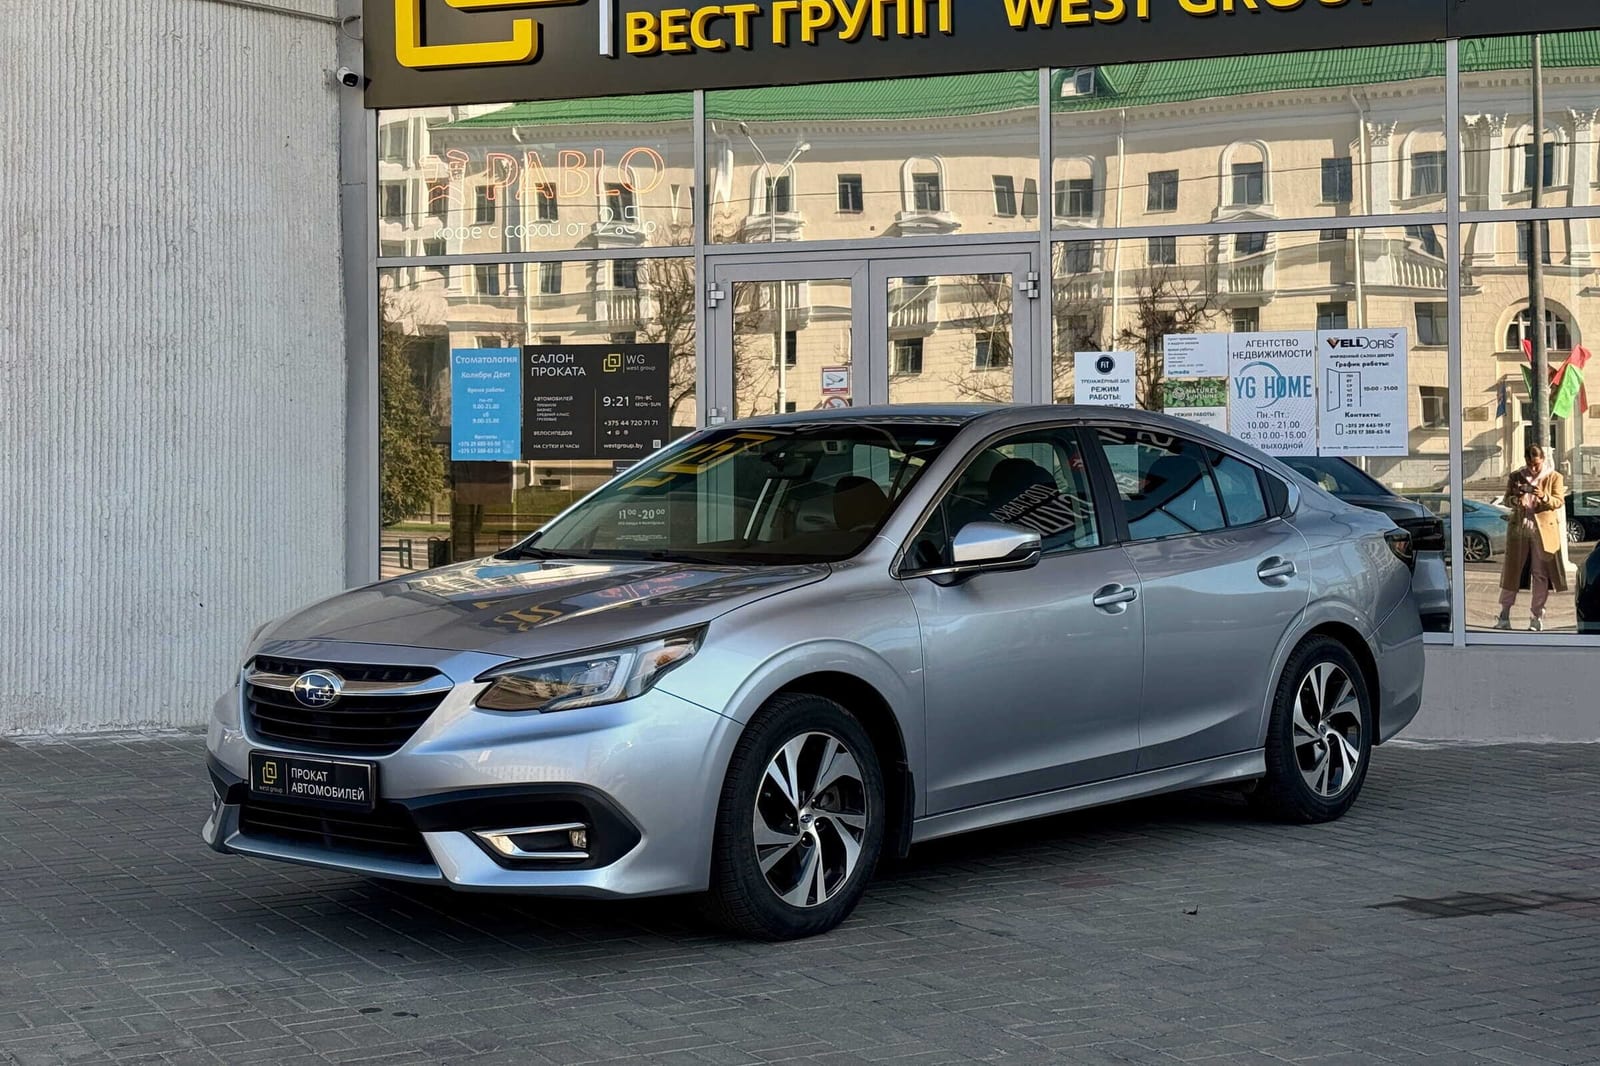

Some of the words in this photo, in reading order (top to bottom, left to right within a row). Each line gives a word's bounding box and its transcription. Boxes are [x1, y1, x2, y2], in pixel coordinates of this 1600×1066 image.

[626, 3, 760, 54] ВЕСТ
[772, 0, 953, 44] ГРУПП
[486, 147, 665, 200] PABLO
[1245, 338, 1299, 348] АГЕНТСТВО
[456, 355, 518, 364] Стоматология
[531, 353, 574, 364] САЛОН
[626, 354, 645, 364] WG
[1232, 349, 1312, 360] НЕДВИЖИМОСТИ
[531, 366, 587, 377] ПРОКАТА
[1234, 376, 1256, 399] YG
[1264, 375, 1313, 398] HOME
[602, 396, 629, 407] 9:21
[1344, 411, 1381, 419] Контакты:
[1247, 421, 1270, 429] 10.00
[1277, 420, 1300, 429] 21.00
[1257, 431, 1307, 439] 10.00-15.00
[603, 442, 644, 450] westgroup.by
[1260, 442, 1304, 451] выходной
[291, 767, 328, 782] ПРОКАТ
[291, 782, 365, 801] АВТОМОБИЛЕЙ
